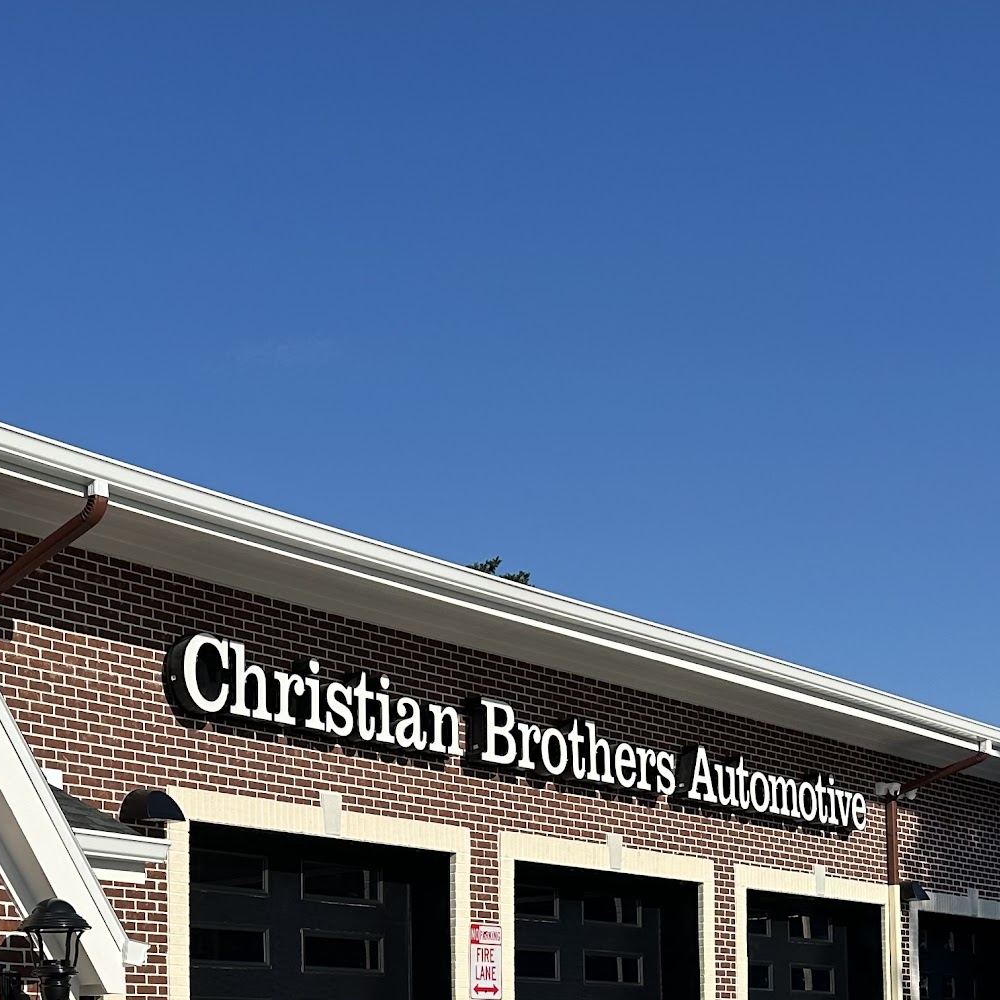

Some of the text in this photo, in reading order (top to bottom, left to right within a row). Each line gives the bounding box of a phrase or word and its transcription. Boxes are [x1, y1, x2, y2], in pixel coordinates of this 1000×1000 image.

[183, 633, 867, 831] Christian Brothers Automotive
[477, 948, 494, 962] FIRE
[476, 966, 496, 980] LANE
